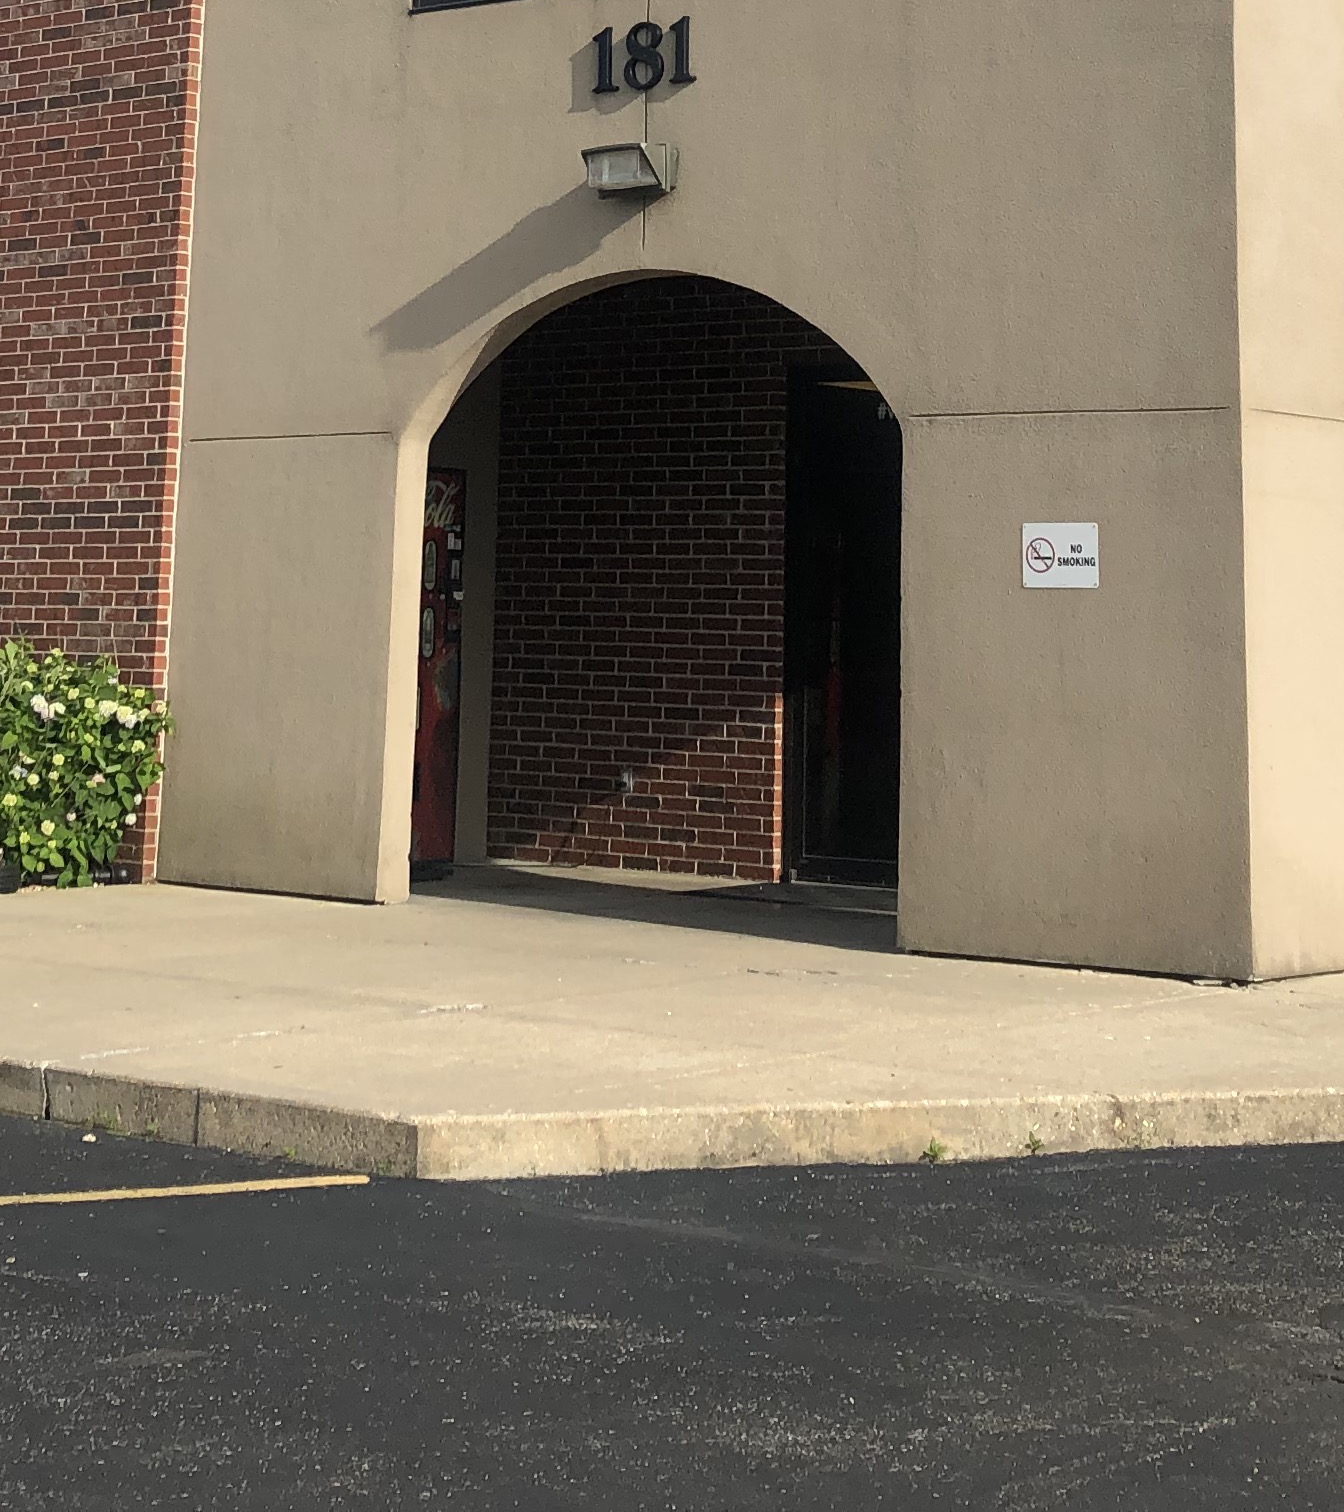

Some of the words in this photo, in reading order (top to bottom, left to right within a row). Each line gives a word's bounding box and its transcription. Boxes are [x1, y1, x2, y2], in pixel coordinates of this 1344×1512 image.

[592, 16, 697, 94] 181
[1070, 544, 1083, 554] NO
[1057, 557, 1096, 567] SMOKING
